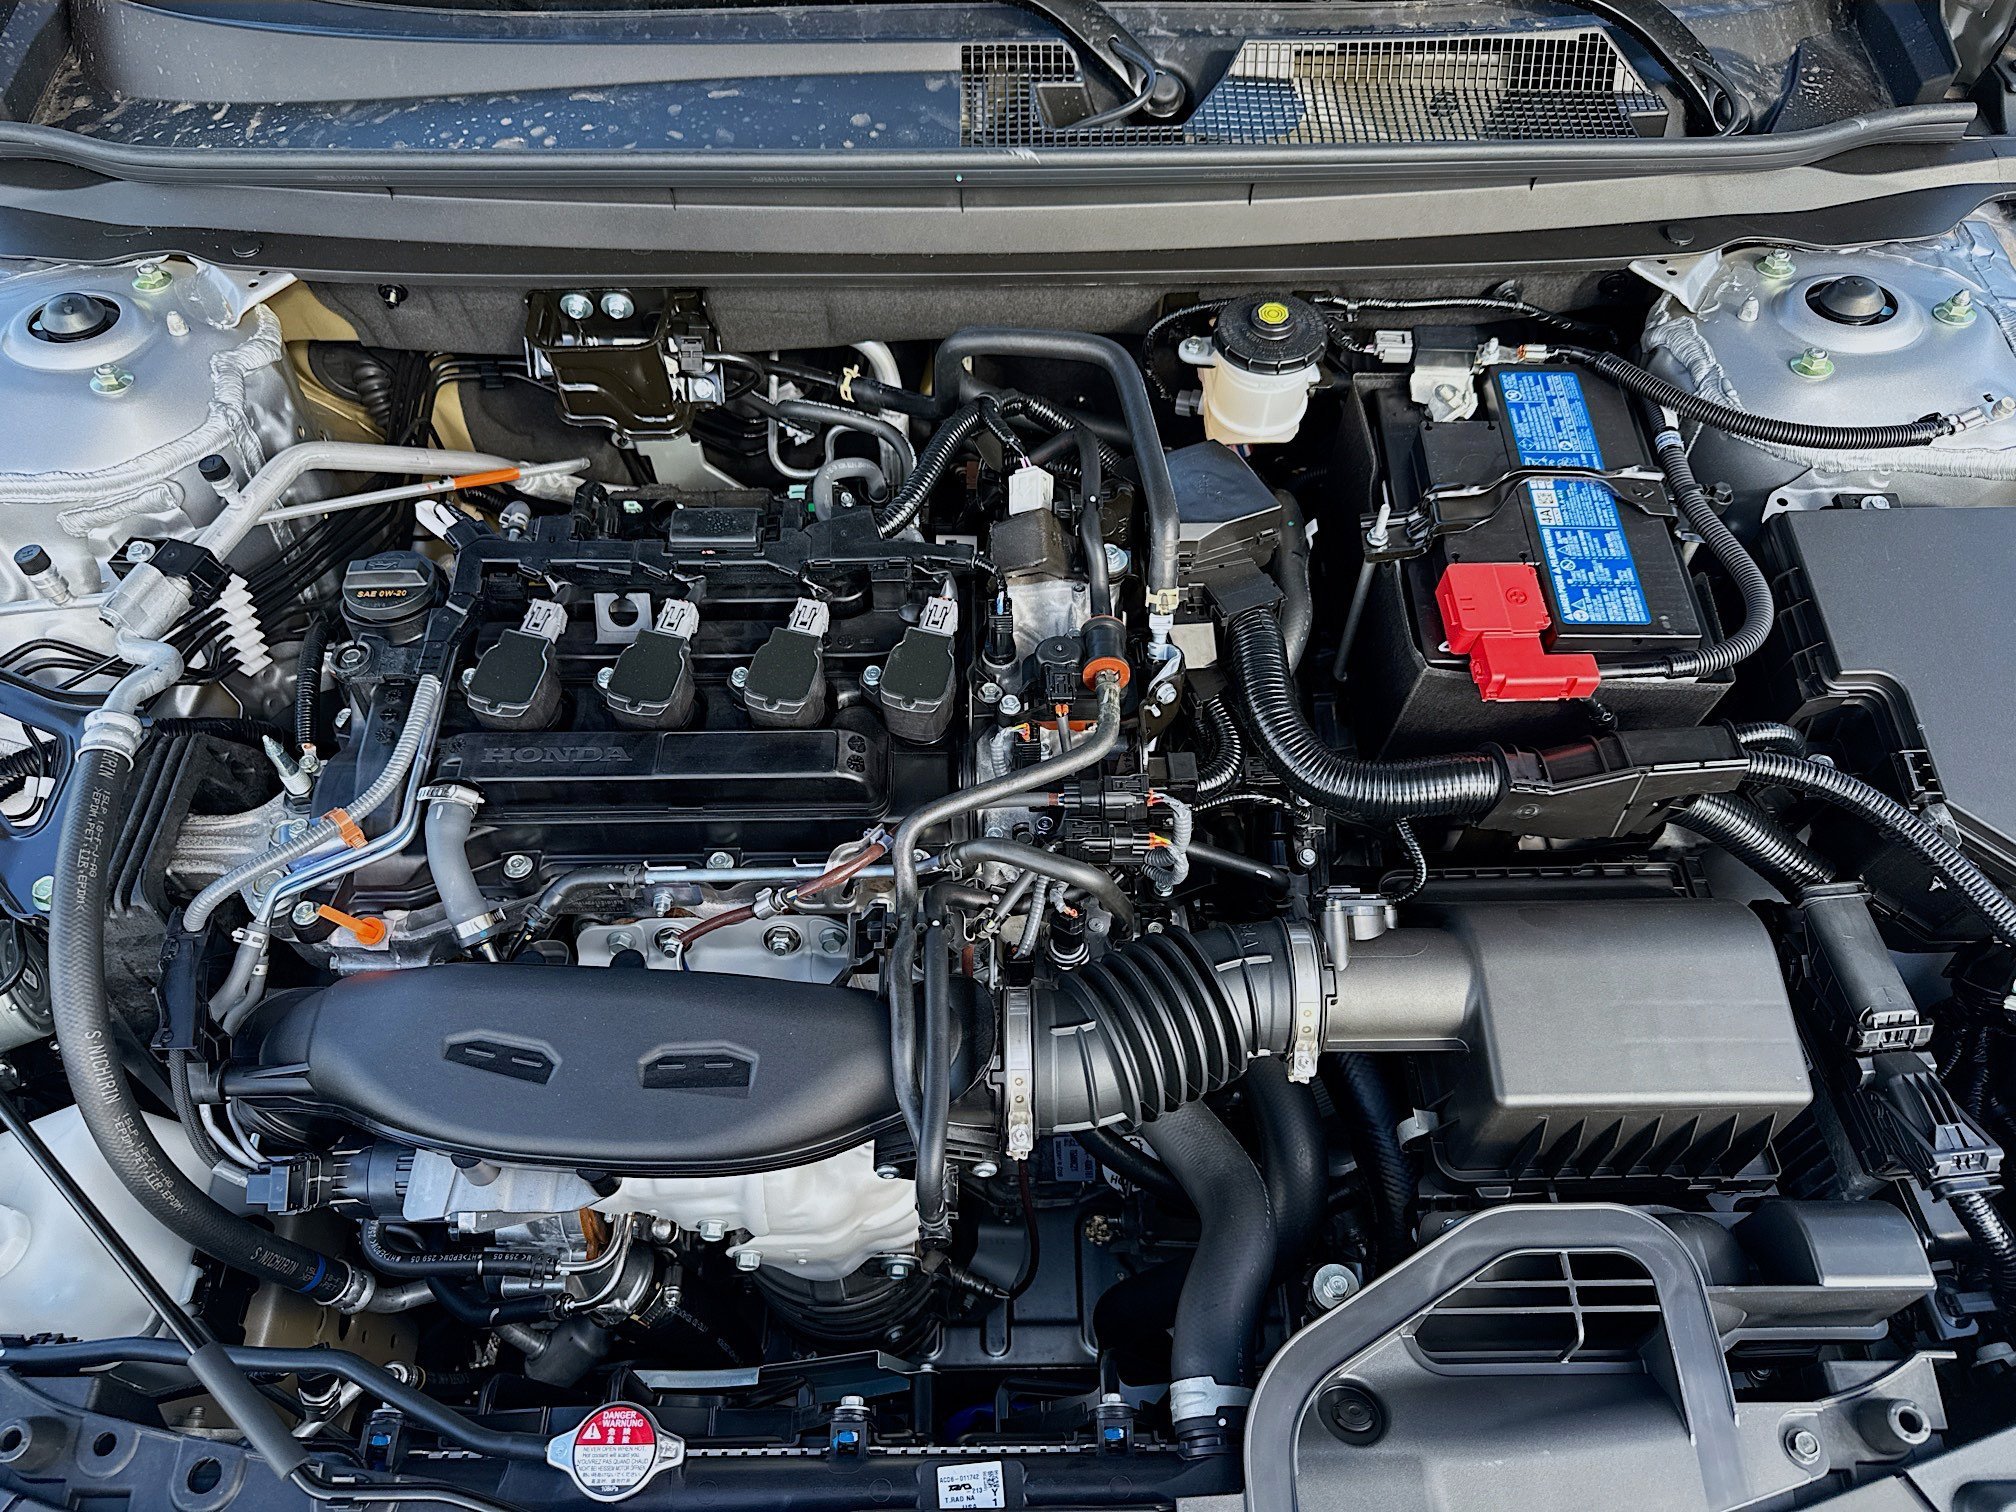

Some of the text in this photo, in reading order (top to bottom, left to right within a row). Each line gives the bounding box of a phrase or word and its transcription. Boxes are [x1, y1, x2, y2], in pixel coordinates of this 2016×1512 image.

[1541, 509, 1551, 523] 4A
[357, 589, 407, 598] SAE 0W-20
[481, 746, 633, 762] HONDA
[602, 1411, 637, 1419] DANGER
[602, 1419, 644, 1427] WARNUNG
[992, 1498, 998, 1506] 1
